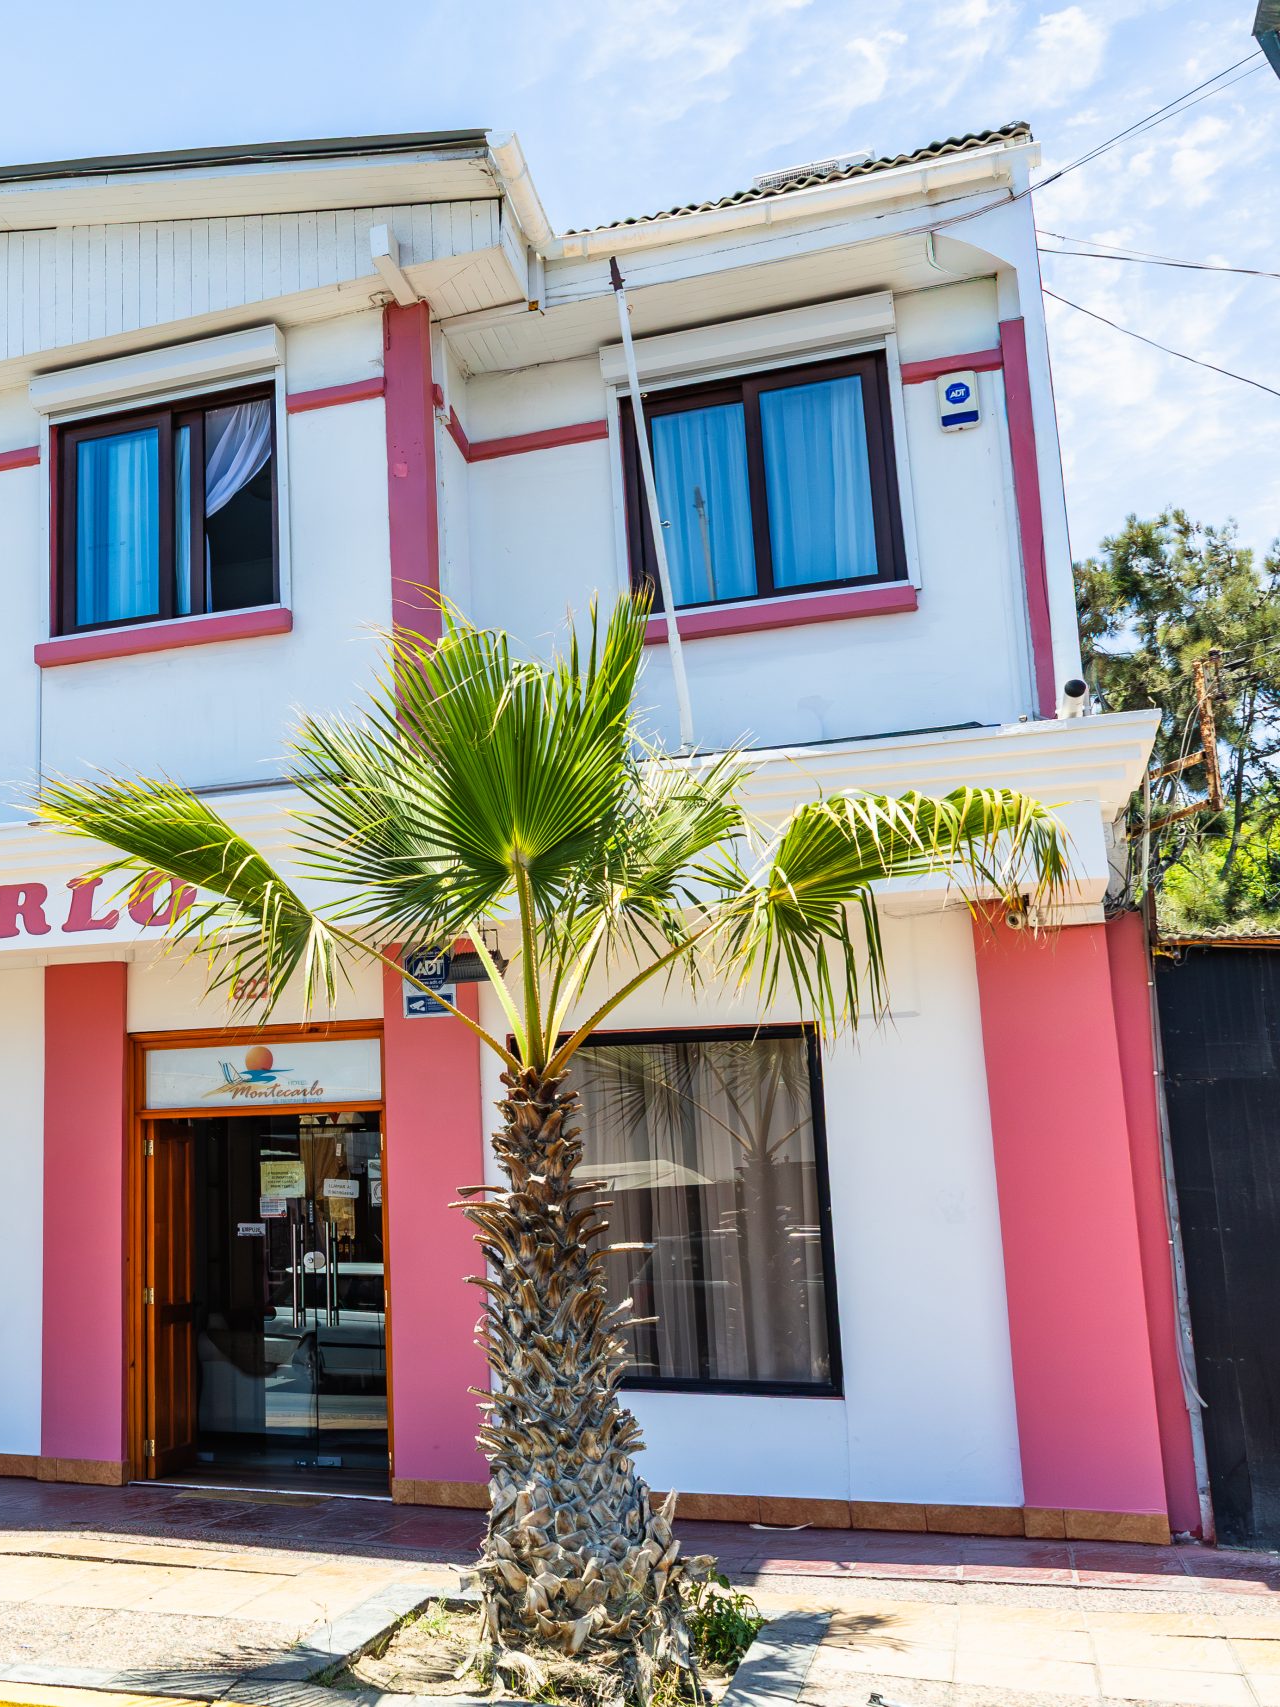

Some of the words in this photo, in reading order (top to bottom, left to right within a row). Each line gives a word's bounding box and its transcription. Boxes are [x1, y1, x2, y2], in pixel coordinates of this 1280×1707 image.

[950, 388, 966, 399] ADT
[413, 960, 444, 977] ADT
[230, 1079, 324, 1100] Montecarlo
